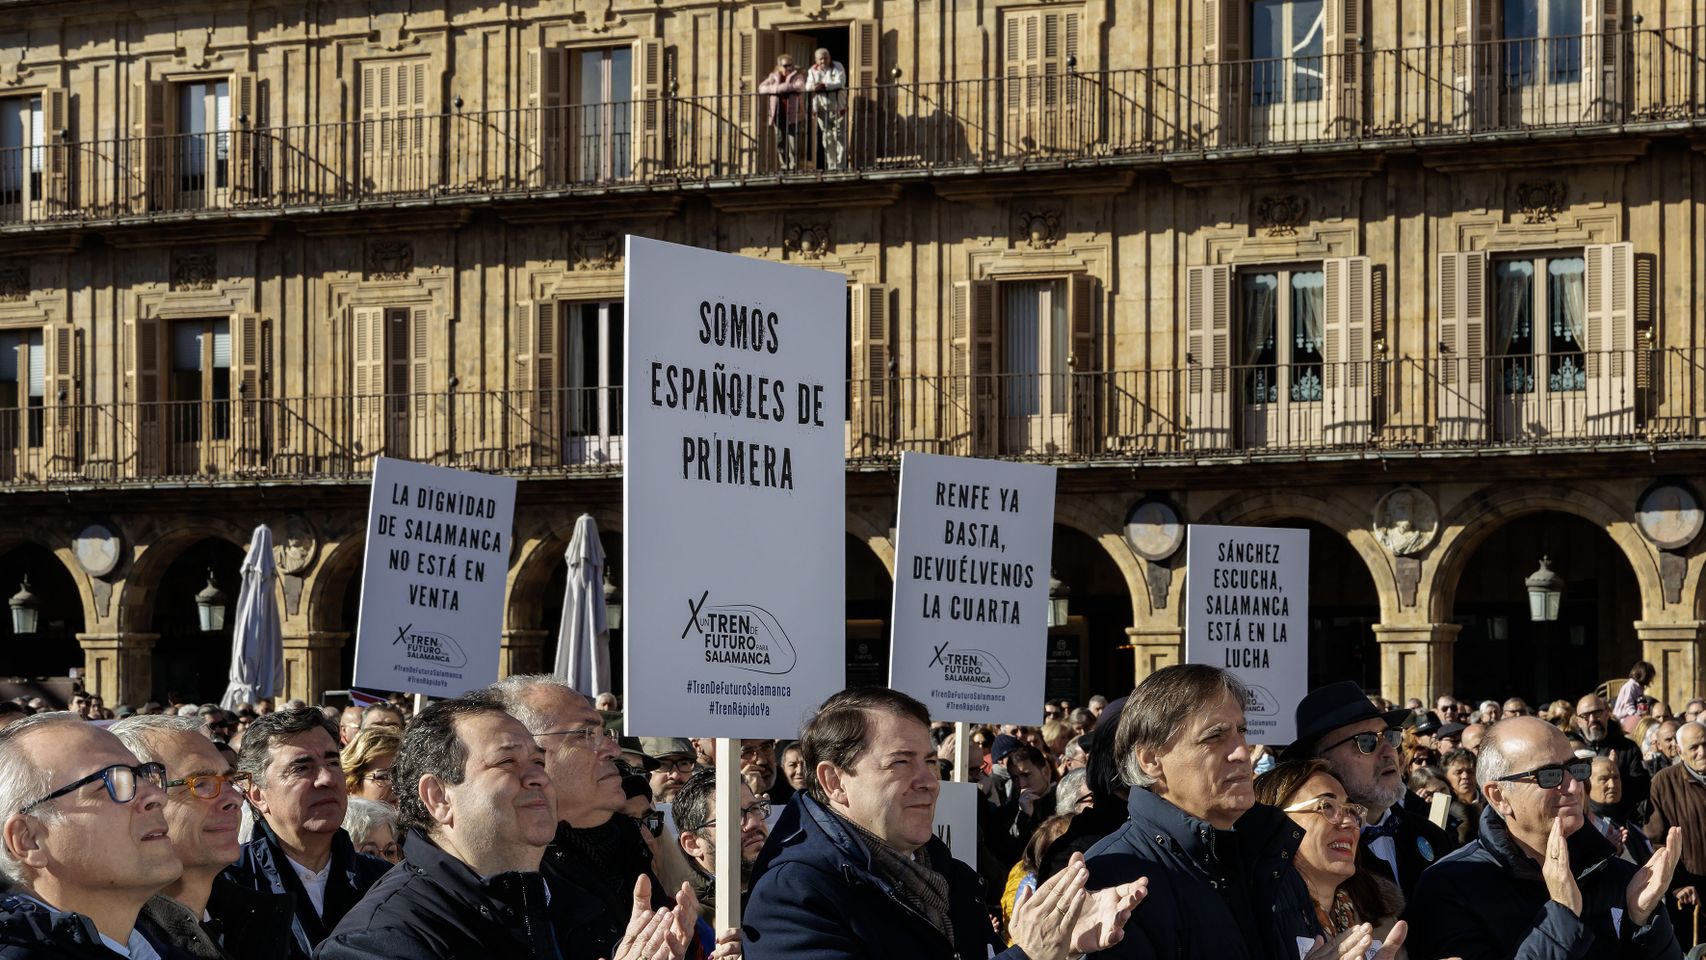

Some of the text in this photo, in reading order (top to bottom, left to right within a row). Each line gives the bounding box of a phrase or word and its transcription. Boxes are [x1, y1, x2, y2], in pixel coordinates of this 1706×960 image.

[699, 300, 779, 354] SOMOS
[651, 361, 824, 427] ESPAÑOLES DE
[682, 435, 793, 490] PRIMERA
[392, 483, 496, 519] LA DIGNIDAD
[935, 481, 1019, 513] RENFE YA
[378, 514, 501, 553] DE SALAMANCA
[944, 519, 1006, 552] BASTA,
[1218, 539, 1280, 564] SÁNCHEZ
[389, 549, 485, 583] NO ESTÁ EN
[912, 555, 1034, 589] DEVUÉLVENOS
[1213, 568, 1283, 593] ESCUCHA,
[409, 584, 459, 611] VENTA
[922, 593, 1020, 625] LA CUARTA
[1206, 595, 1290, 617] SALAMANCA
[700, 617, 709, 627] UN
[707, 613, 750, 635] TREN
[750, 626, 759, 635] DE
[1207, 619, 1288, 642] ESTÁ EN LA
[407, 643, 441, 655] FUTURO
[410, 634, 438, 647] TREN
[704, 633, 757, 651] FUTURO
[407, 651, 450, 663] SALAMANCA
[705, 650, 771, 665] SALAMANCA
[947, 653, 978, 667] TREN
[1225, 647, 1270, 669] LUCHA
[944, 664, 982, 676] FUTURO
[944, 673, 992, 684] SALAMANCA
[686, 679, 792, 698] #TrenDeFuturoSalamanca
[709, 700, 770, 718] #TrenRápidoYa
